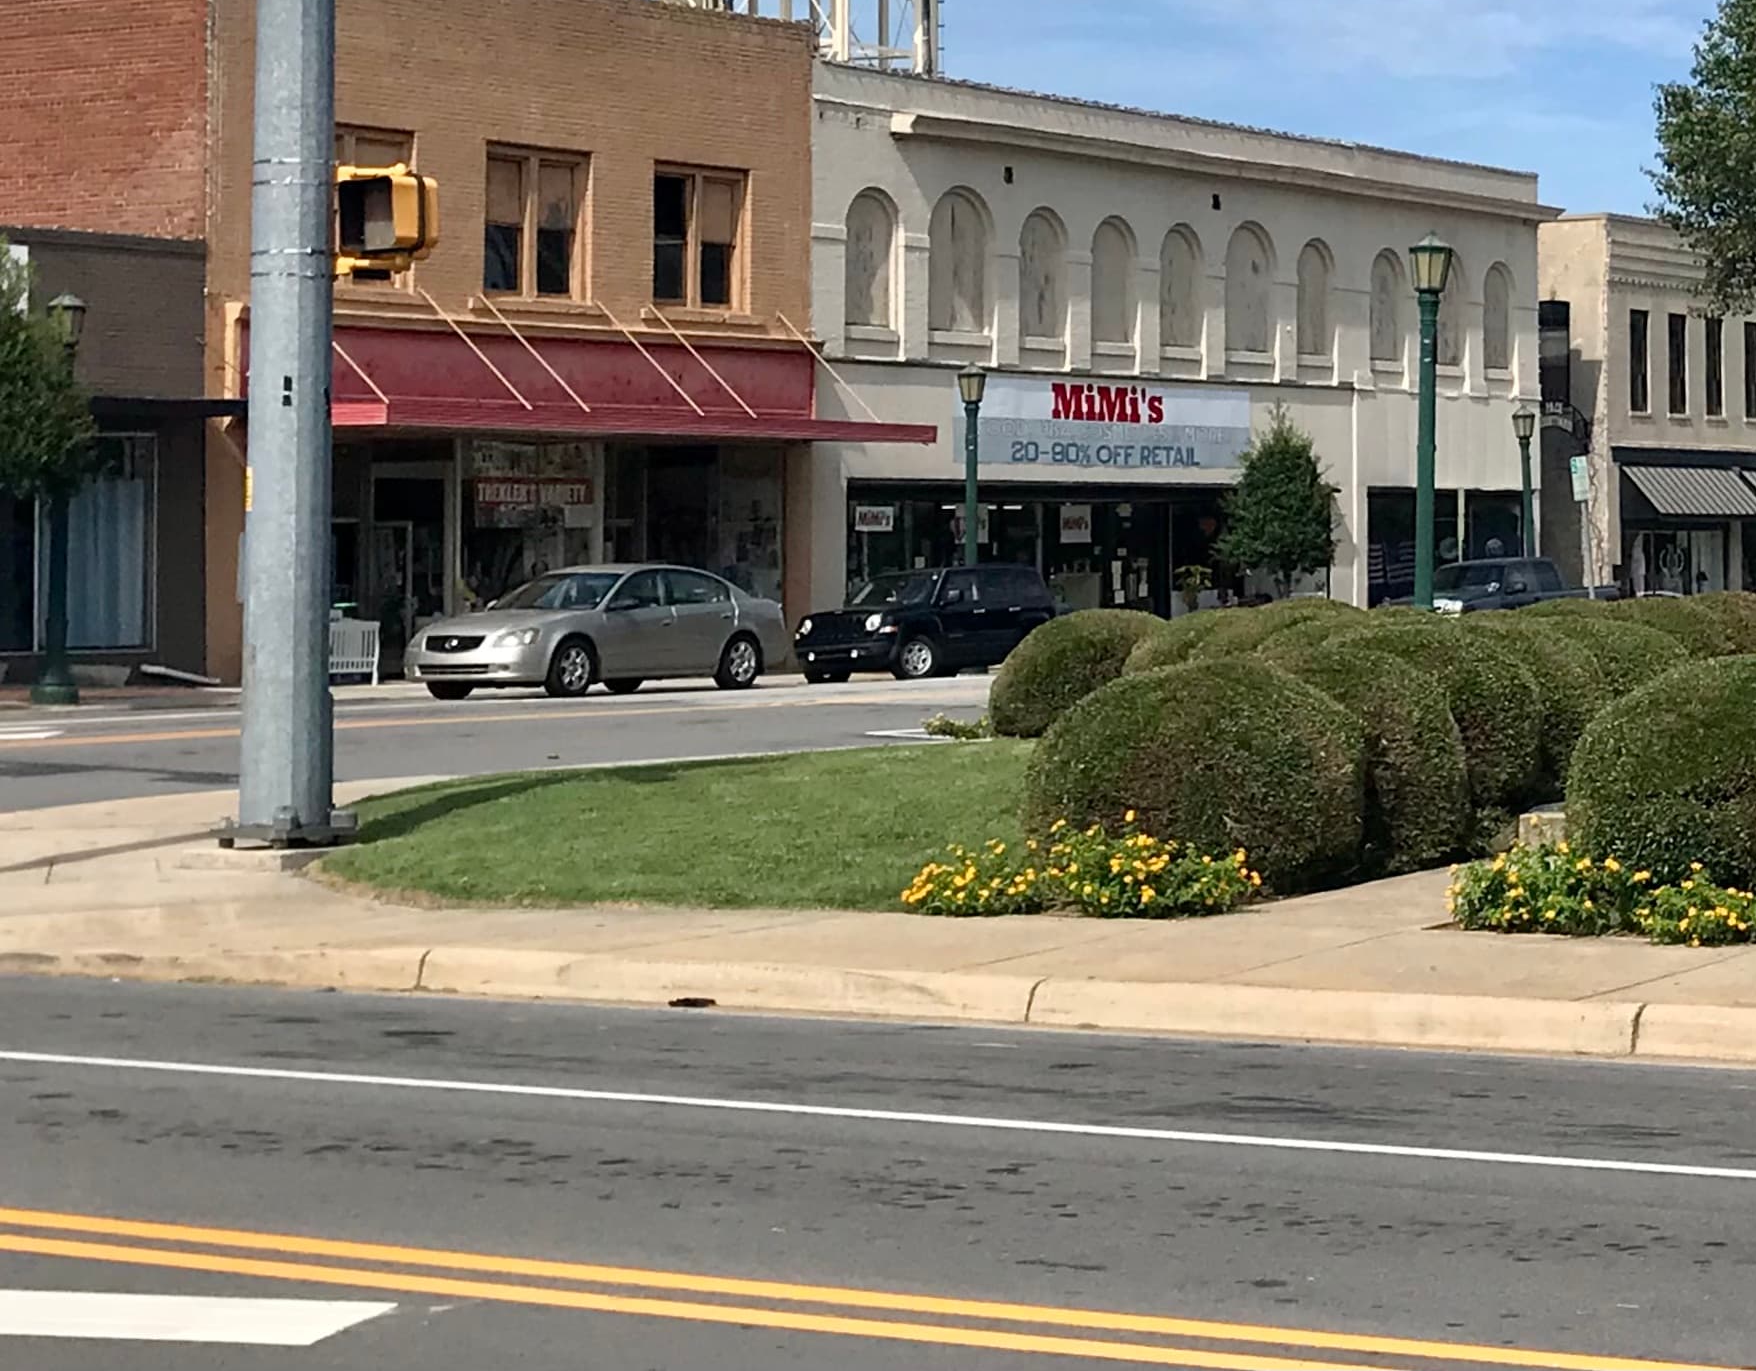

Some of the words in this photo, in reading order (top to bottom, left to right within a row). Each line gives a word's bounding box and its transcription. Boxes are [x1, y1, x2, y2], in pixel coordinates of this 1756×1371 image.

[1051, 382, 1164, 424] MiMi's
[1011, 440, 1091, 465] 20-80%
[1096, 445, 1135, 466] OFF
[1140, 446, 1201, 467] RETAIL
